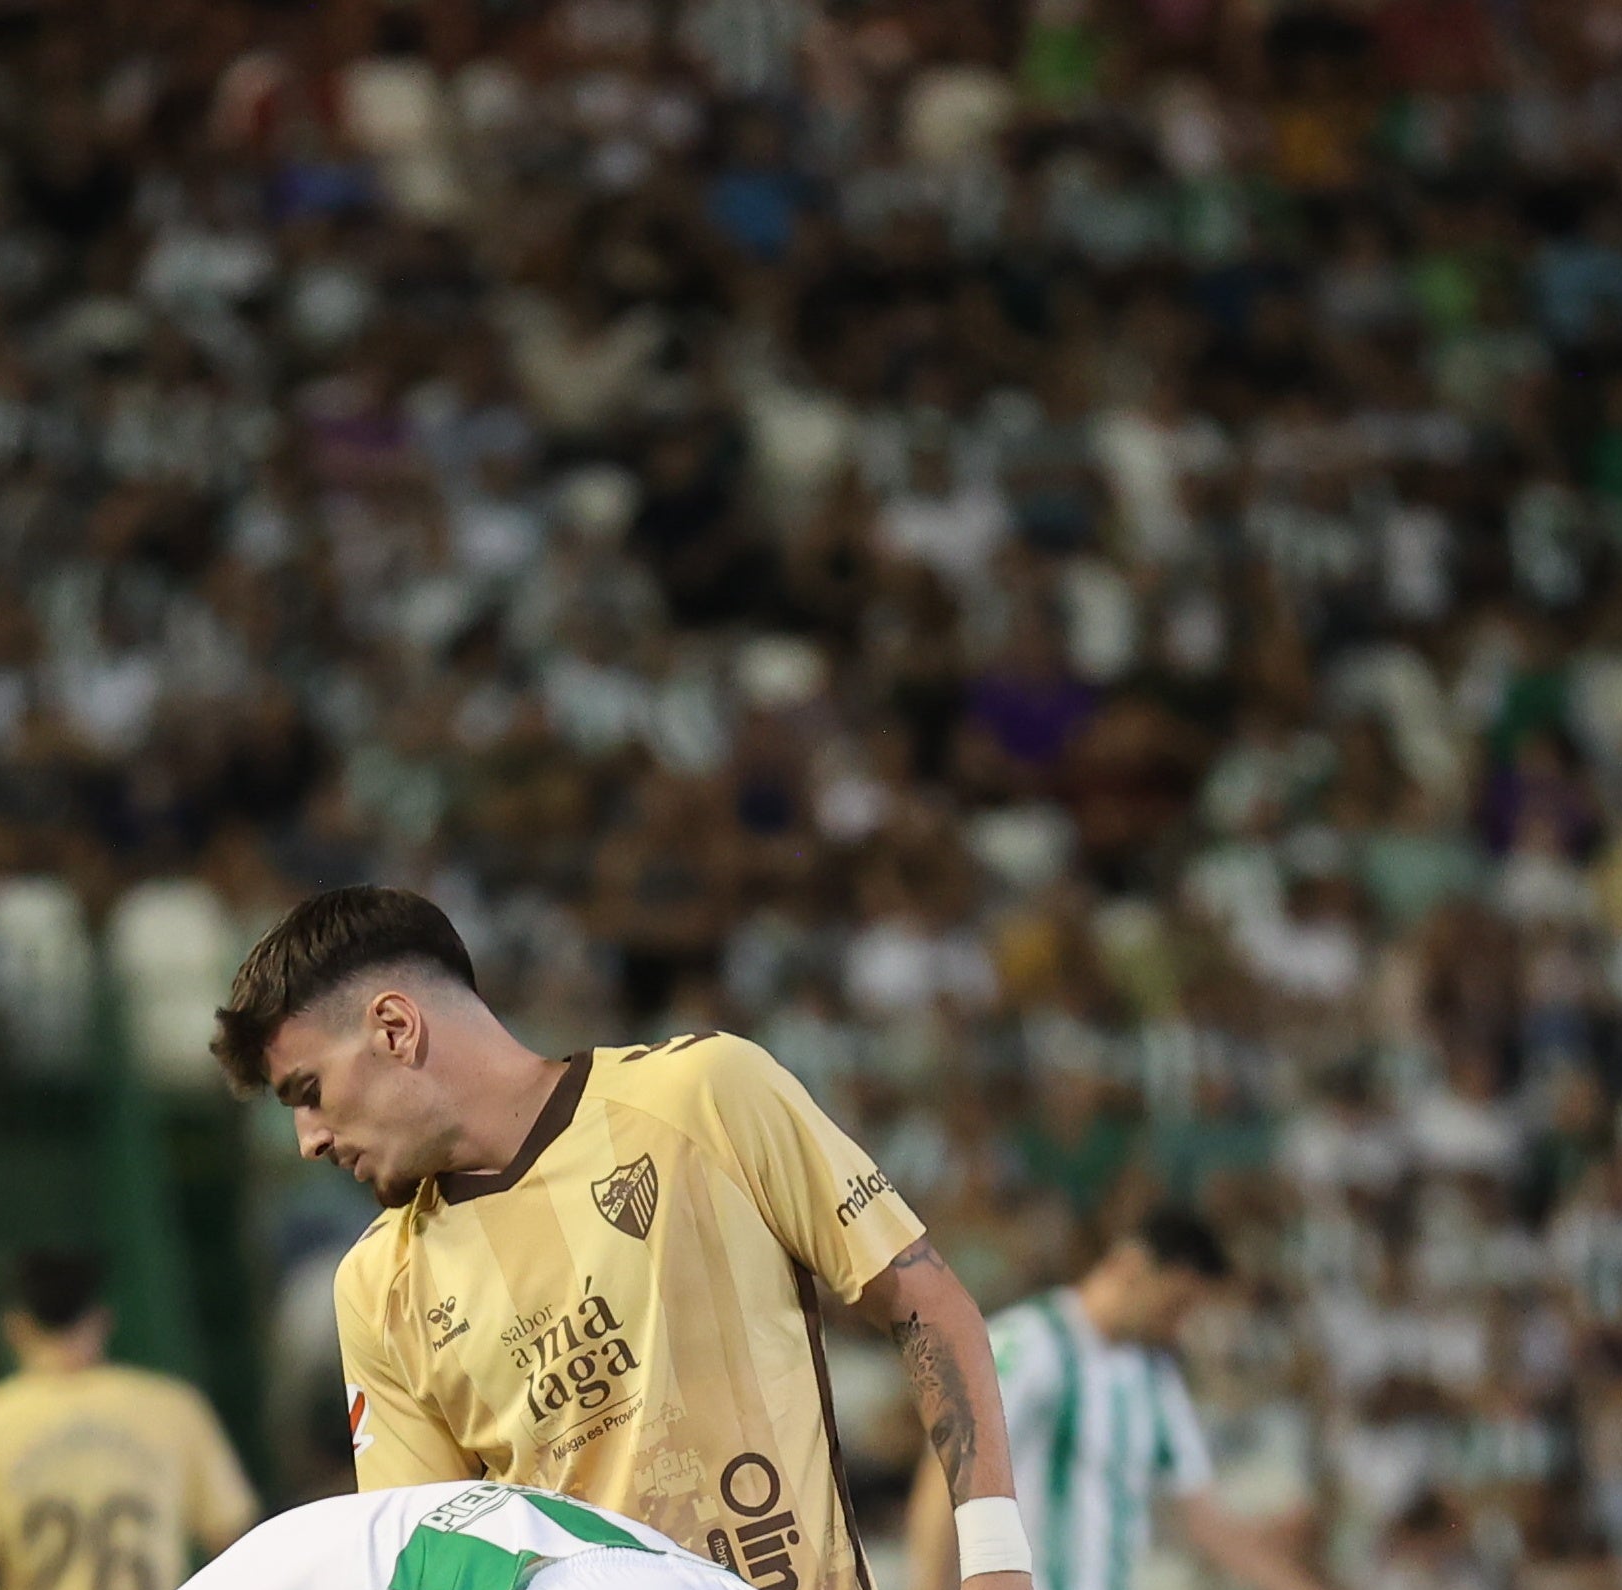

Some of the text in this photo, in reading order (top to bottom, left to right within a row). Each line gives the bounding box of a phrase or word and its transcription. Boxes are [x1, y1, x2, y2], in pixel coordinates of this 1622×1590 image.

[500, 1303, 554, 1347] sabor
[510, 1345, 533, 1370] a
[525, 1337, 642, 1425] laga
[586, 1422, 605, 1442] es
